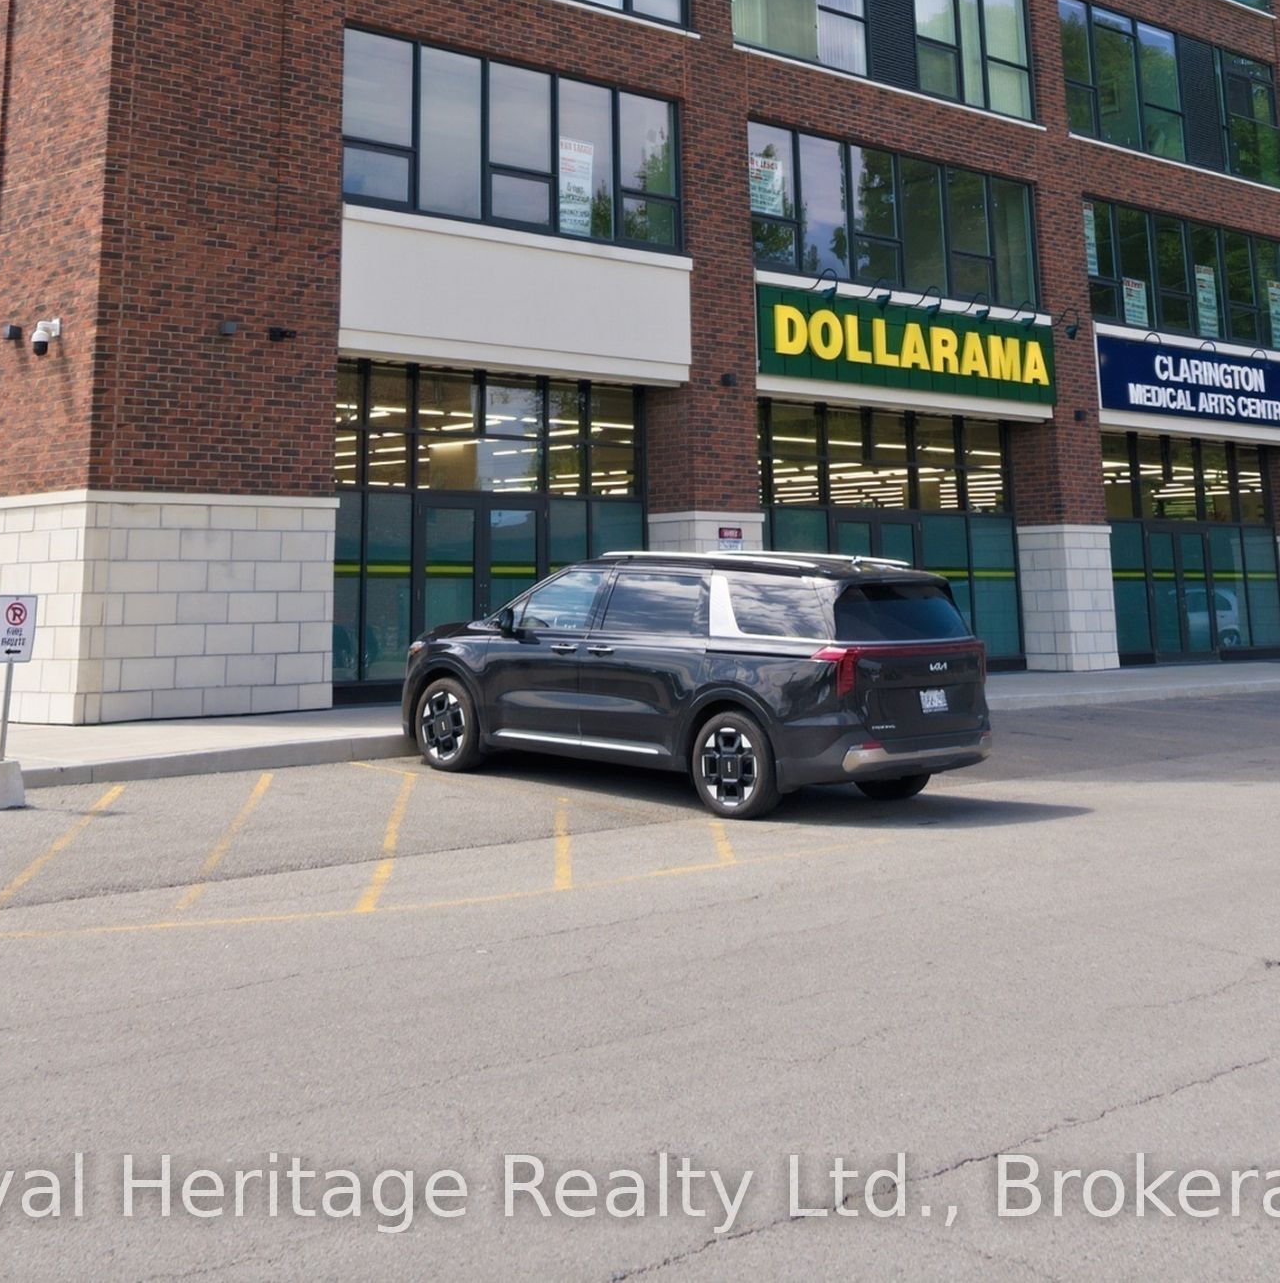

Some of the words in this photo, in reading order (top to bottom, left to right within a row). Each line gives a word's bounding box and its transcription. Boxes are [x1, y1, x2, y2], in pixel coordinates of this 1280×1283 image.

[774, 304, 1050, 386] DOLLARAMA
[1154, 354, 1266, 393] CLARINGTON
[1128, 382, 1196, 412] MEDICAL
[1198, 391, 1236, 416] ARTS
